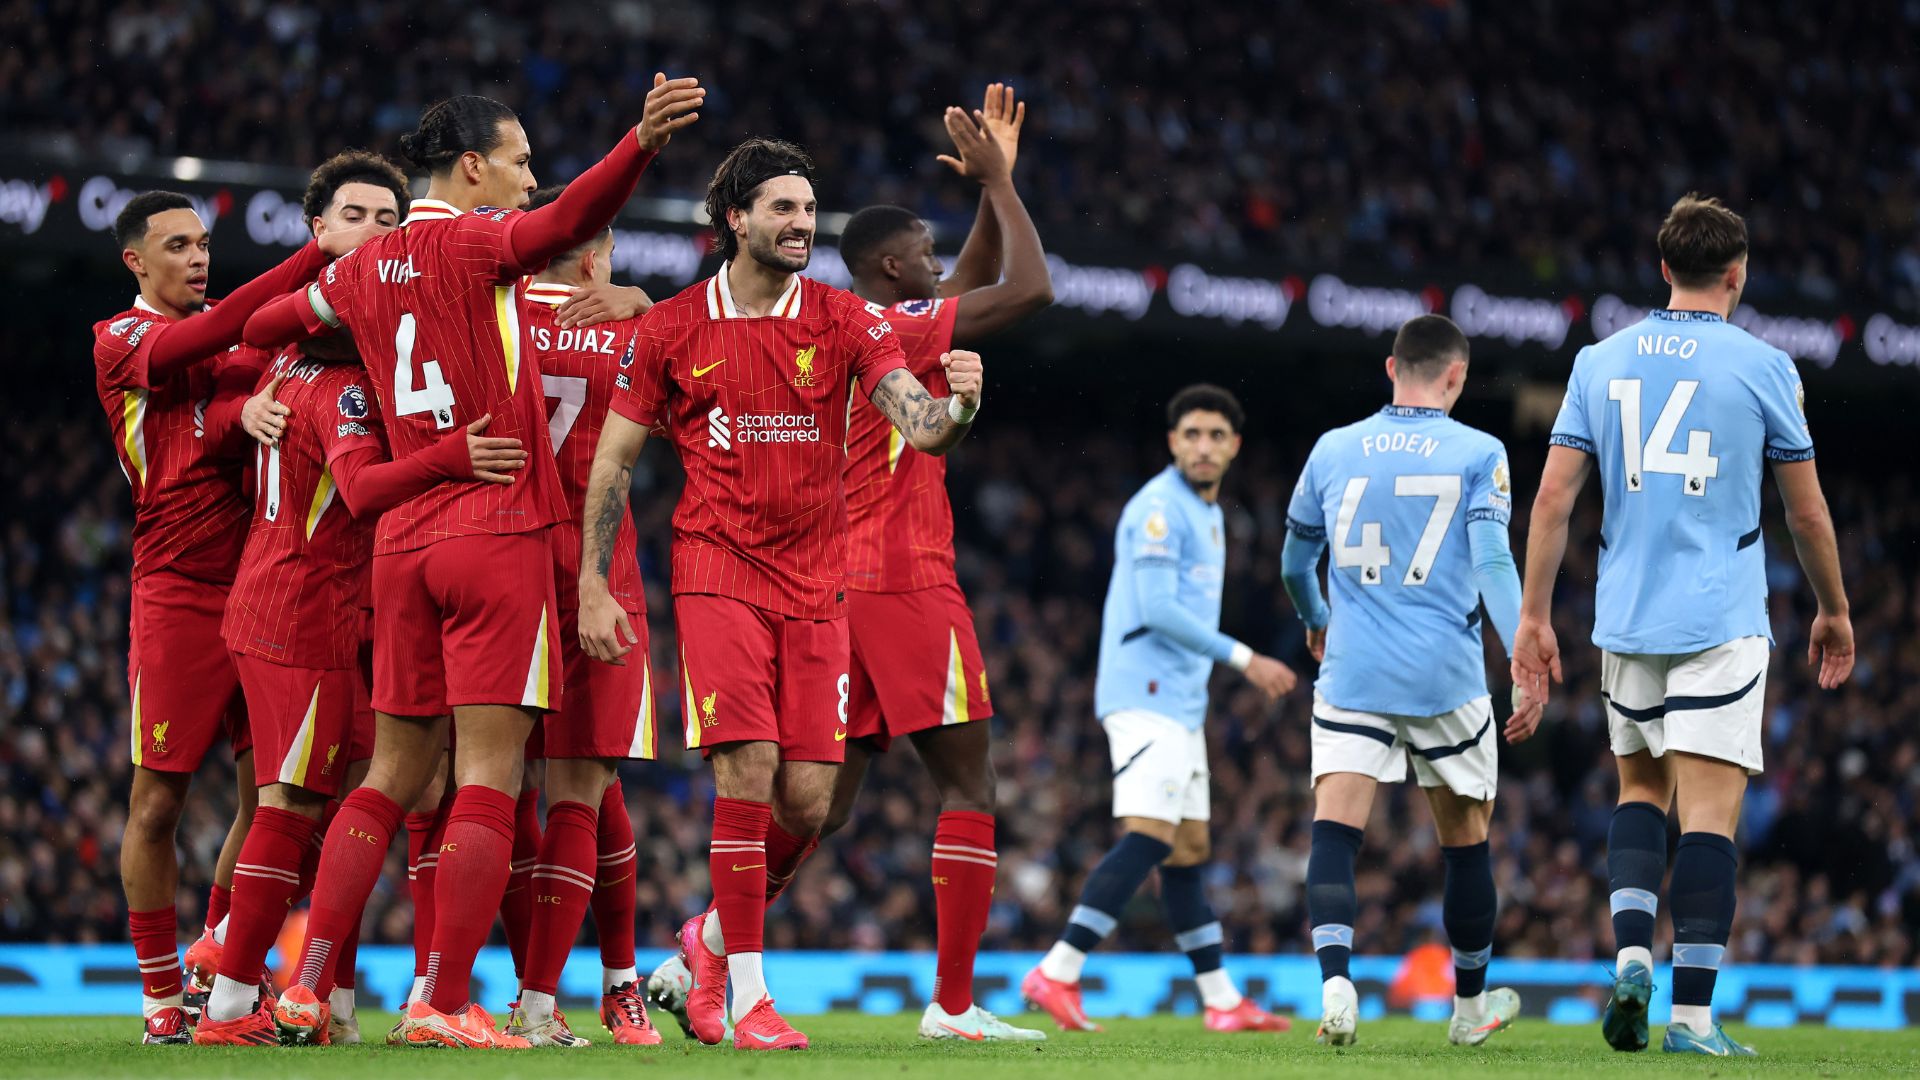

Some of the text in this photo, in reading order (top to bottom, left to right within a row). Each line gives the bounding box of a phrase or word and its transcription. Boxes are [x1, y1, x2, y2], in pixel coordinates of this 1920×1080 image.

[557, 329, 616, 354] DIAZ
[1637, 335, 1698, 360] NICO
[394, 312, 456, 430] 4
[541, 374, 588, 458] 7
[736, 413, 815, 428] standard
[737, 425, 820, 443] chartered
[1362, 432, 1439, 458] FODEN
[1608, 379, 1720, 497] 14
[1334, 475, 1462, 587] 47
[837, 673, 850, 724] 8
[347, 827, 378, 845] LFC
[536, 894, 562, 905] LFC
